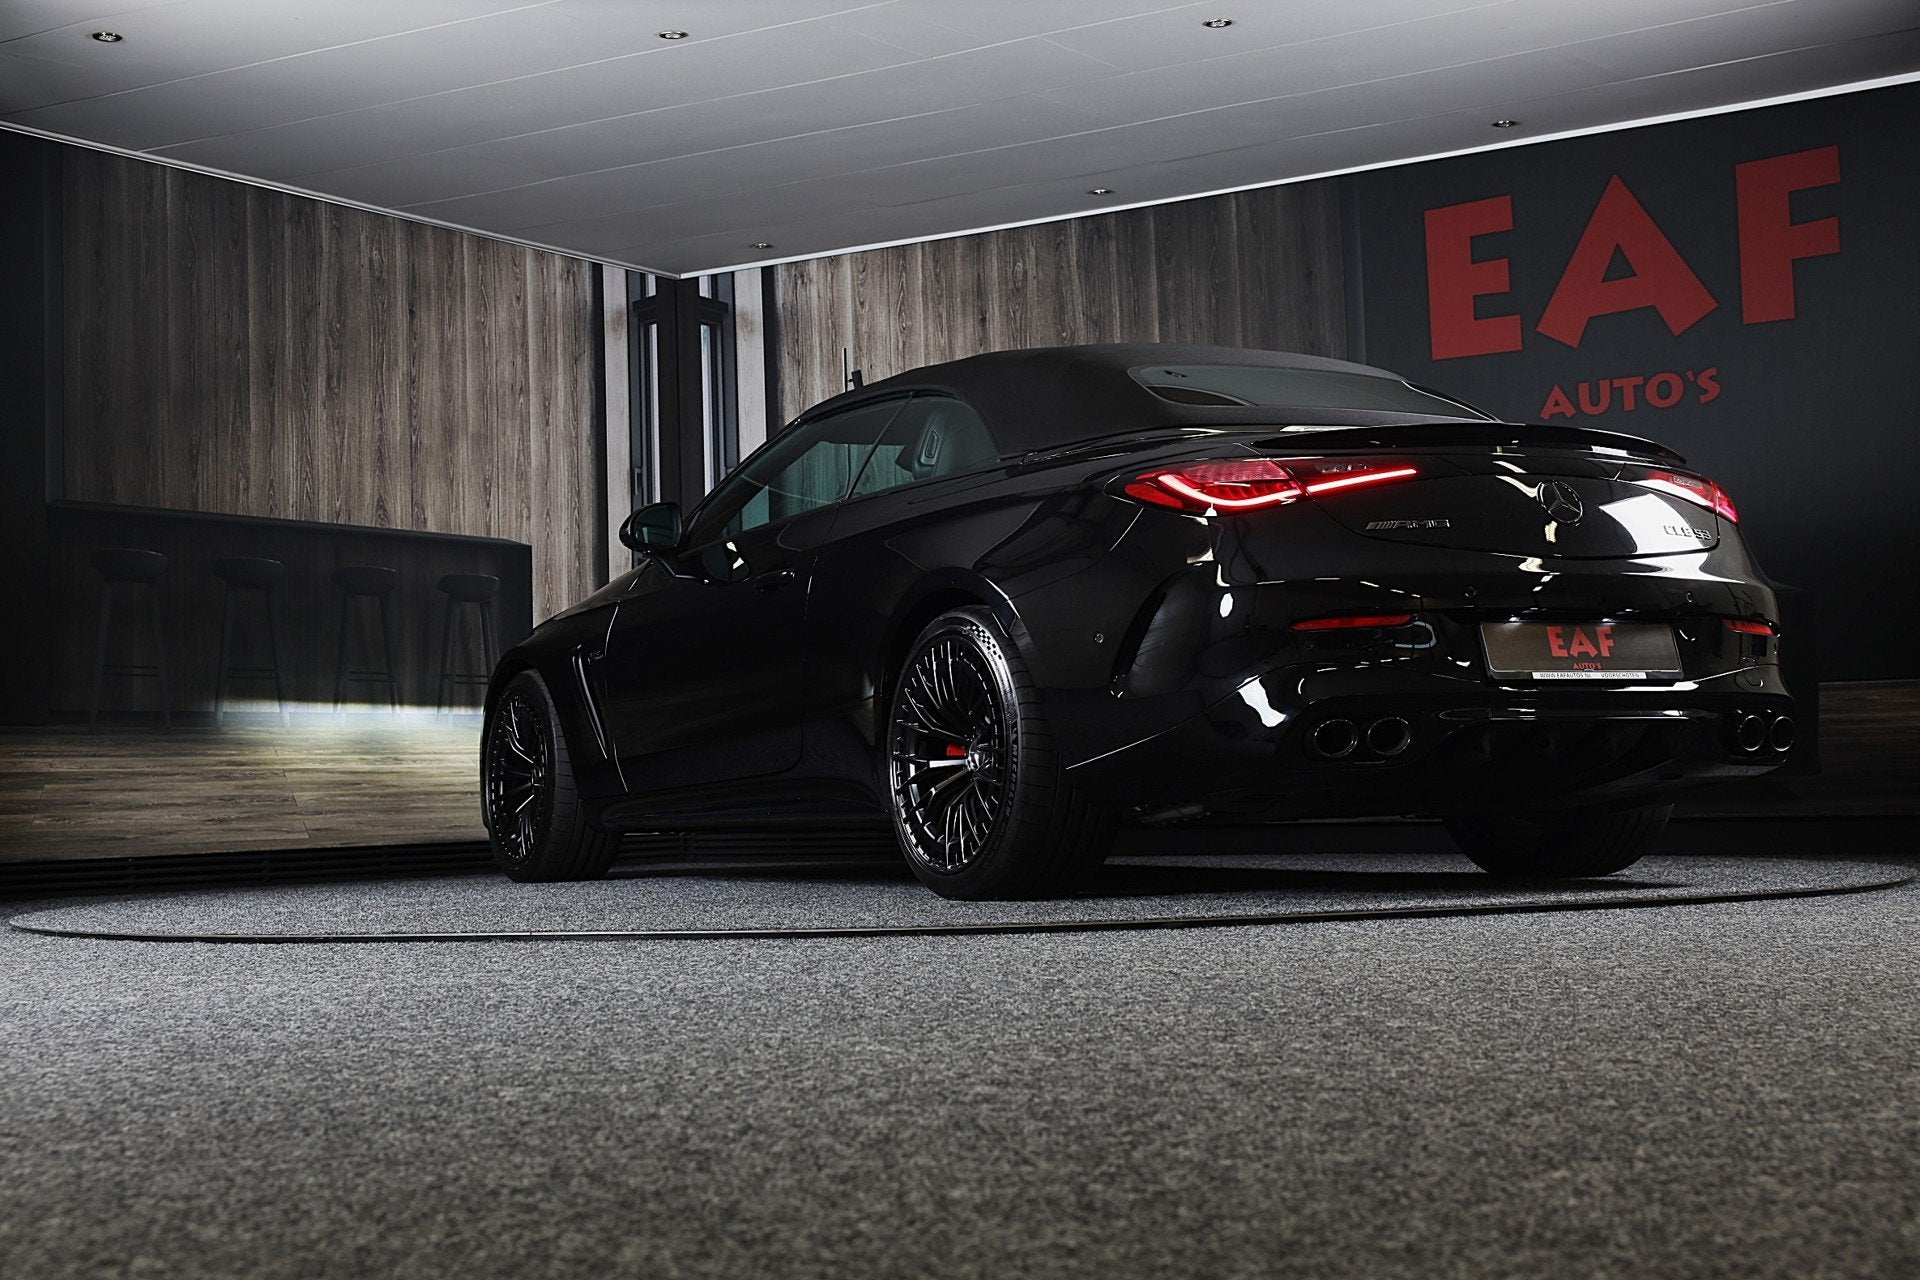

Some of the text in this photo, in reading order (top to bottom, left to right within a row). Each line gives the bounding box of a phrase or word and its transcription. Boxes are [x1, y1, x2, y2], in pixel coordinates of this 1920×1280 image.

[1424, 145, 1842, 360] EAF
[1539, 366, 1721, 421] AUTO'S
[1546, 625, 1615, 658] EAF
[1573, 662, 1602, 670] AUTO'S
